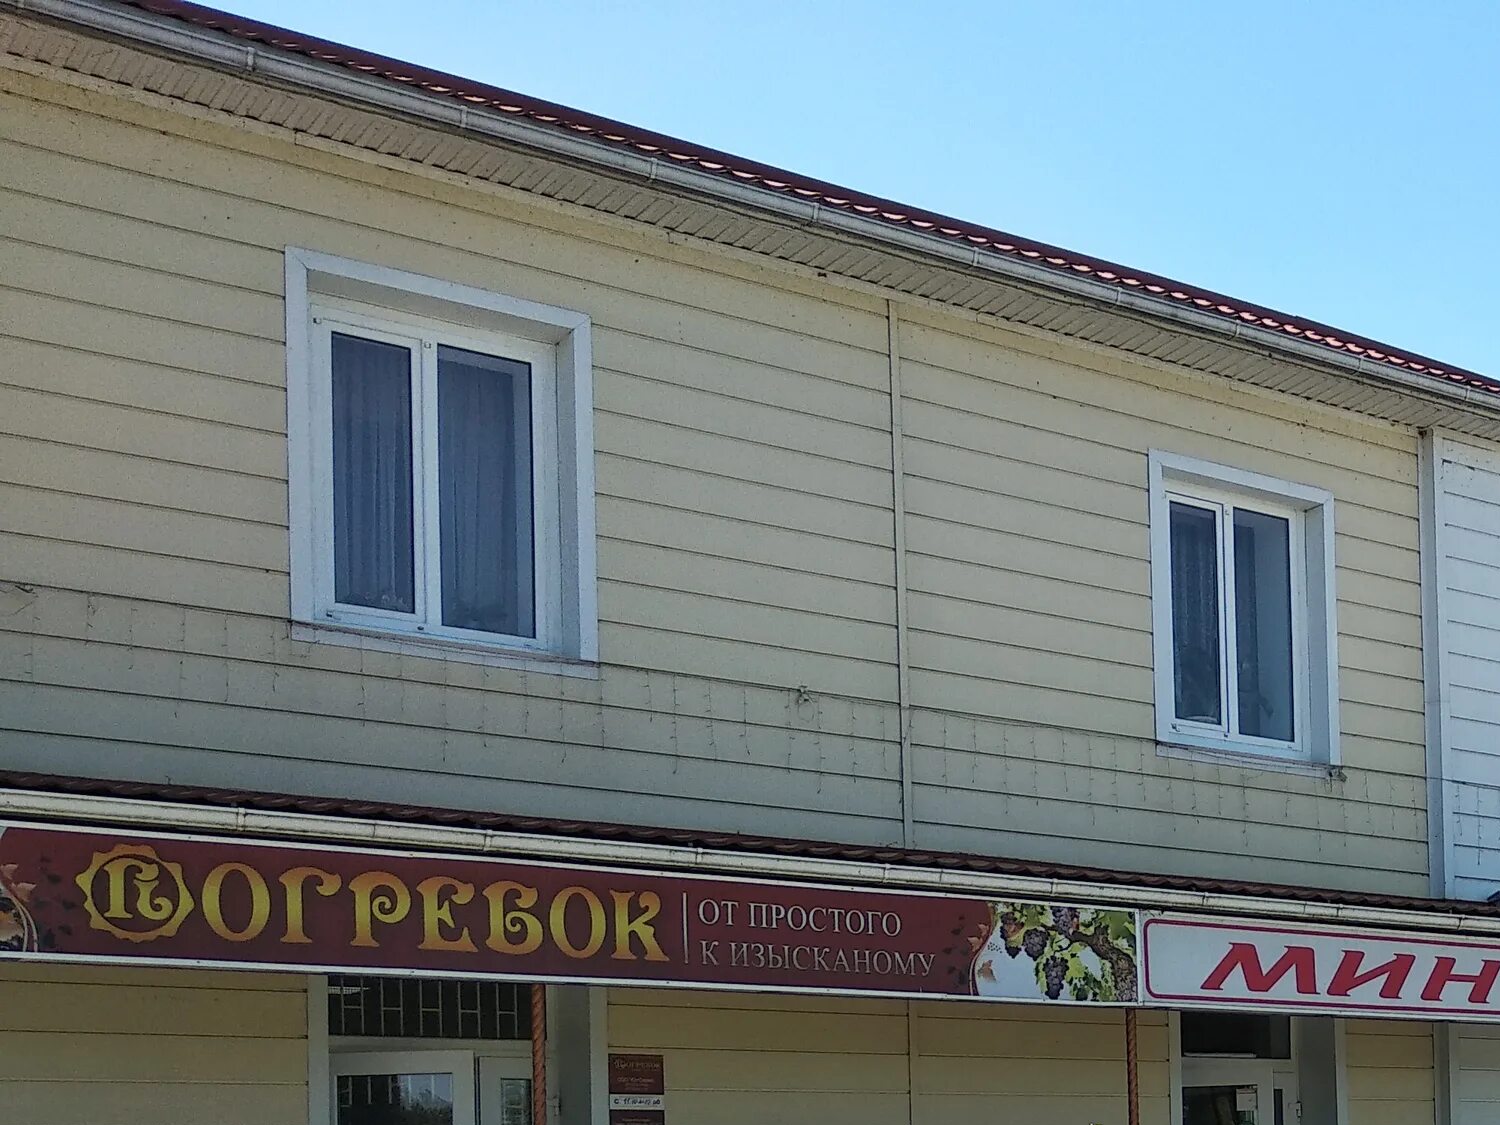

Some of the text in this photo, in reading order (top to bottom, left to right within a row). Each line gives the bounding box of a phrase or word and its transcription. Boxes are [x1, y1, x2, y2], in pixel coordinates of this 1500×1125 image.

[76, 843, 670, 963] ПОГРЕБОК
[698, 899, 901, 936] ОТ ПРОСТОГО
[699, 940, 935, 978] К ИЗЫСКАНОМУ
